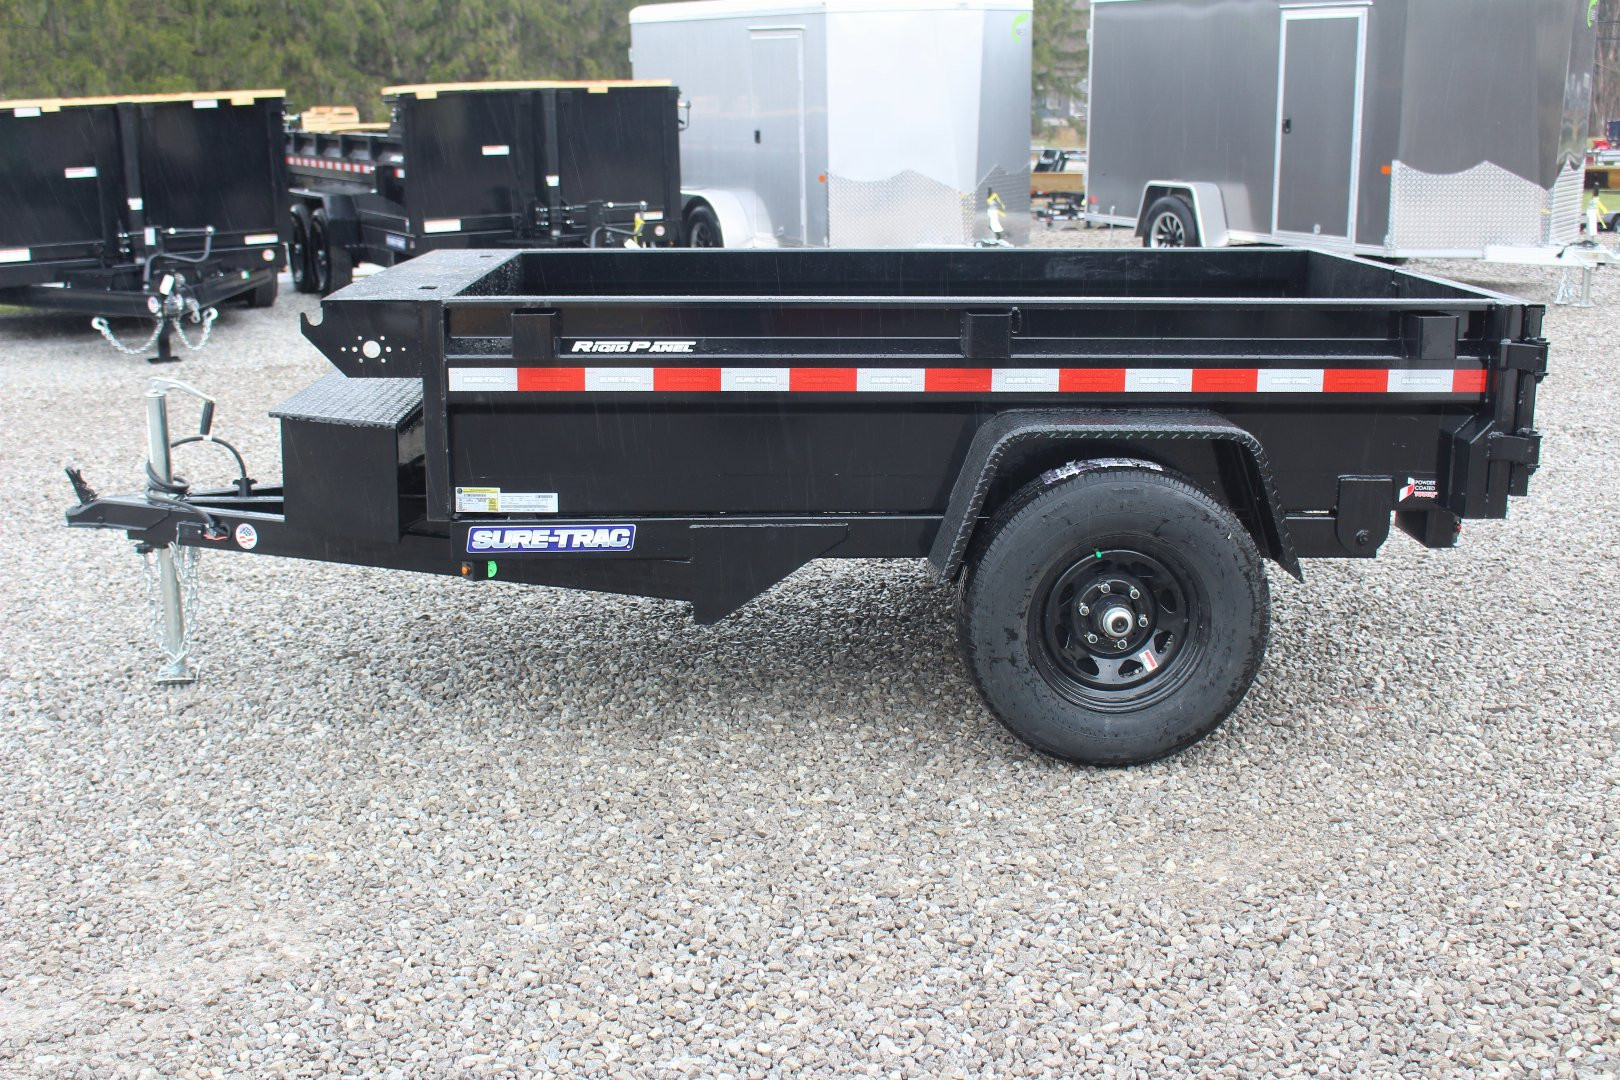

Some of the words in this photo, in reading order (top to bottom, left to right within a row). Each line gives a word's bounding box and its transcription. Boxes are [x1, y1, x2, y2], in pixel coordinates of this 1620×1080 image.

[571, 341, 630, 353] RIGID
[629, 341, 697, 353] PANEL
[472, 528, 631, 549] SURE-TRAC
